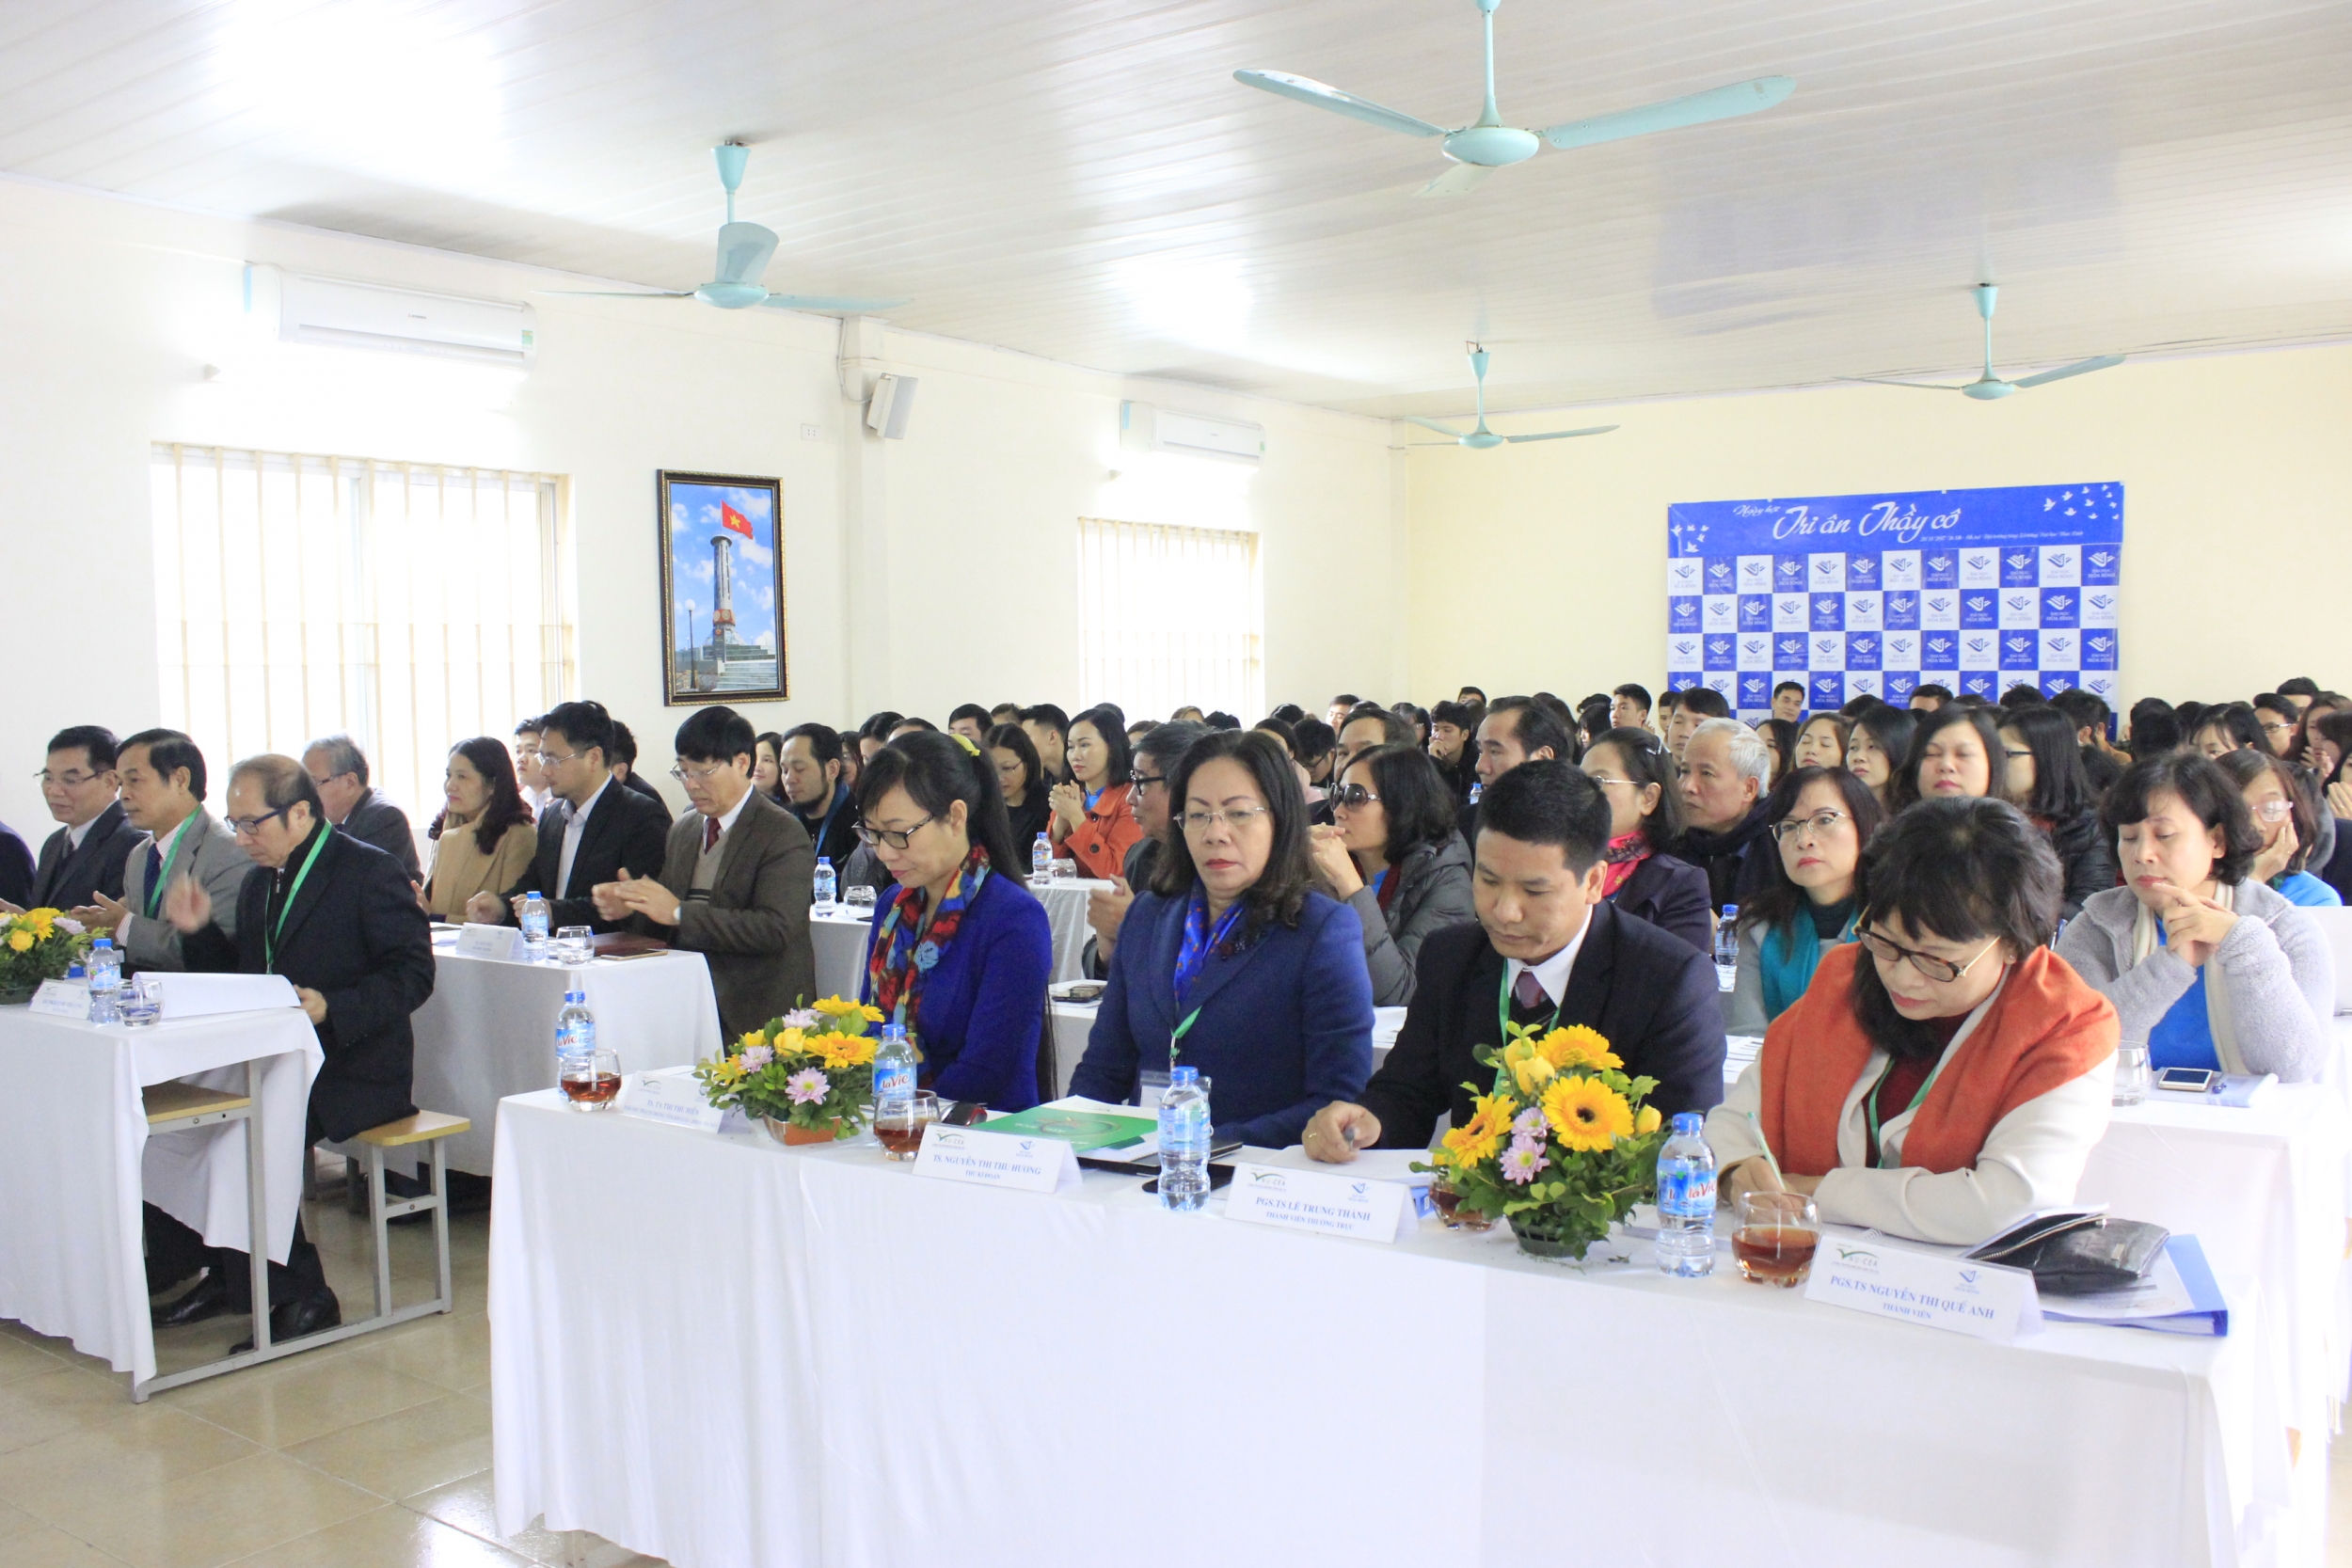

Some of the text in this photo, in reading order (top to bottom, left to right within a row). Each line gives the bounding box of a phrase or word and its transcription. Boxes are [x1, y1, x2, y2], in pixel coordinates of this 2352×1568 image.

[1772, 501, 1962, 544] Tri ân Thầy cô
[882, 1073, 908, 1088] laVie
[1256, 1196, 1286, 1209] PGS.TS
[1288, 1201, 1300, 1211] LÊ
[1303, 1204, 1335, 1216] TRUNG
[1830, 1275, 1867, 1291] PGS.TS
[1869, 1284, 1916, 1302] NGUYỄN
[1941, 1299, 1967, 1313] QUẾ
[1968, 1307, 1994, 1319] ANH
